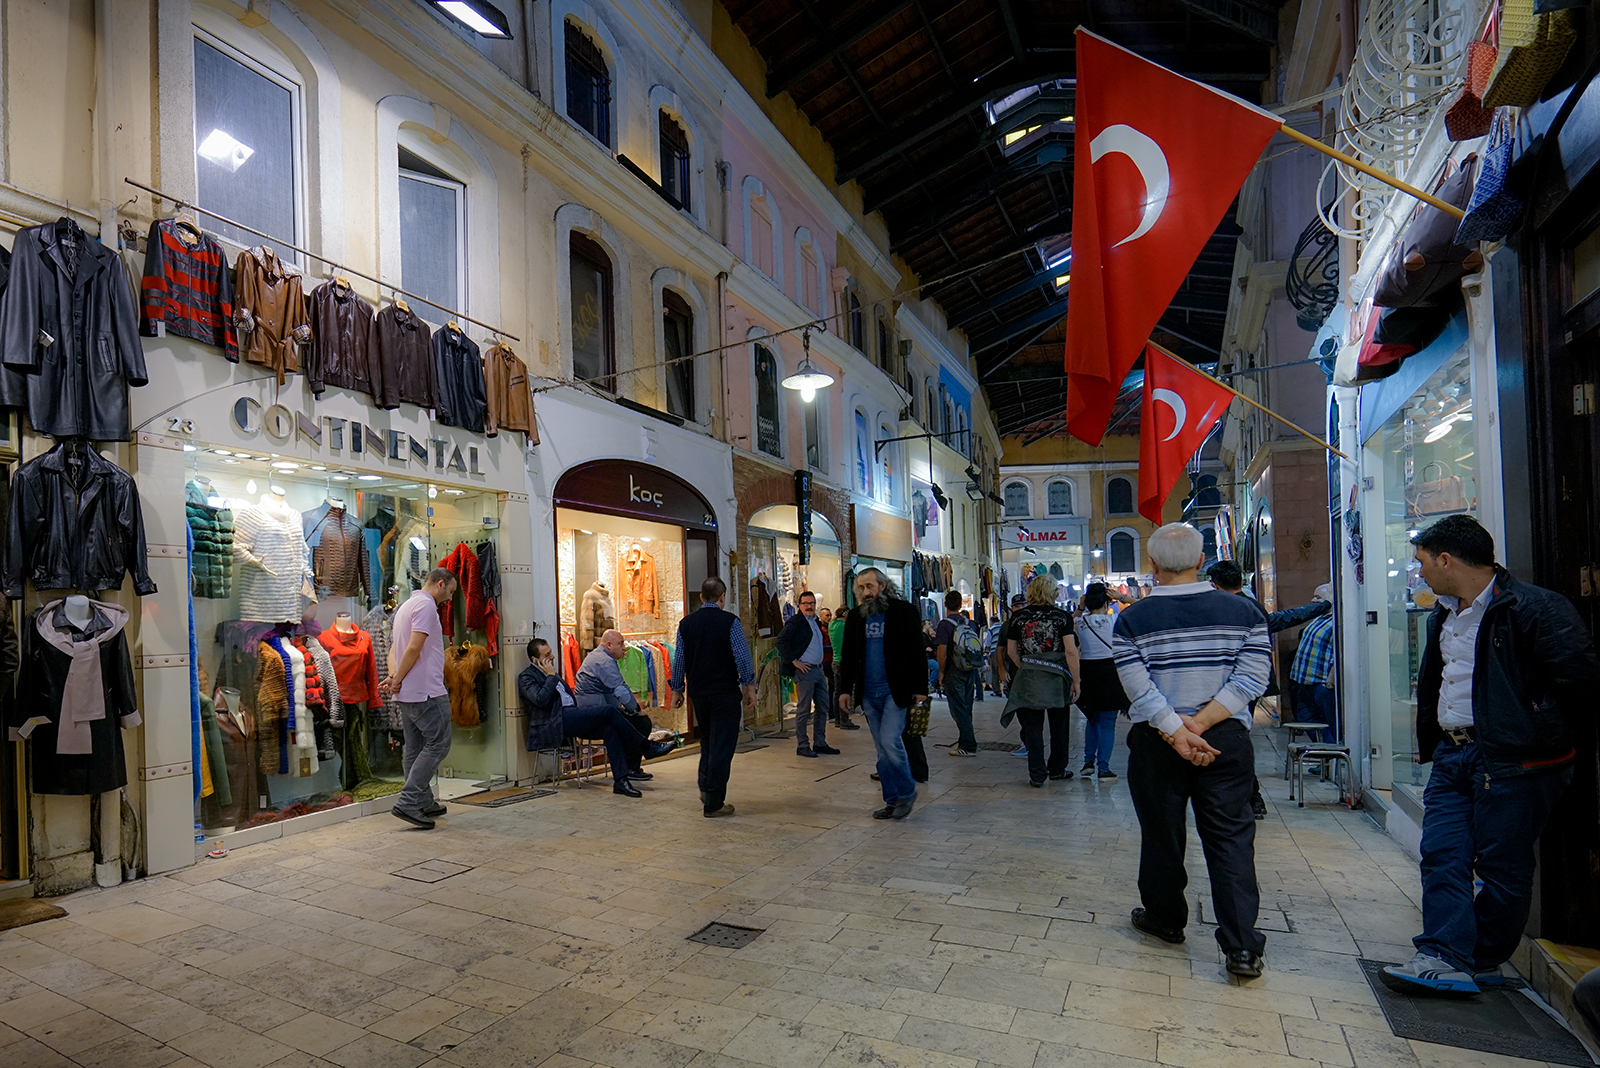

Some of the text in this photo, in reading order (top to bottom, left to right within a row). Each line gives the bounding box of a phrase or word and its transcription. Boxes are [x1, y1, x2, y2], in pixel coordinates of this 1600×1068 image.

[167, 415, 196, 434] 23
[232, 396, 486, 475] CONTINENTAL
[629, 474, 663, 508] koç
[1016, 531, 1067, 542] YILMAZ
